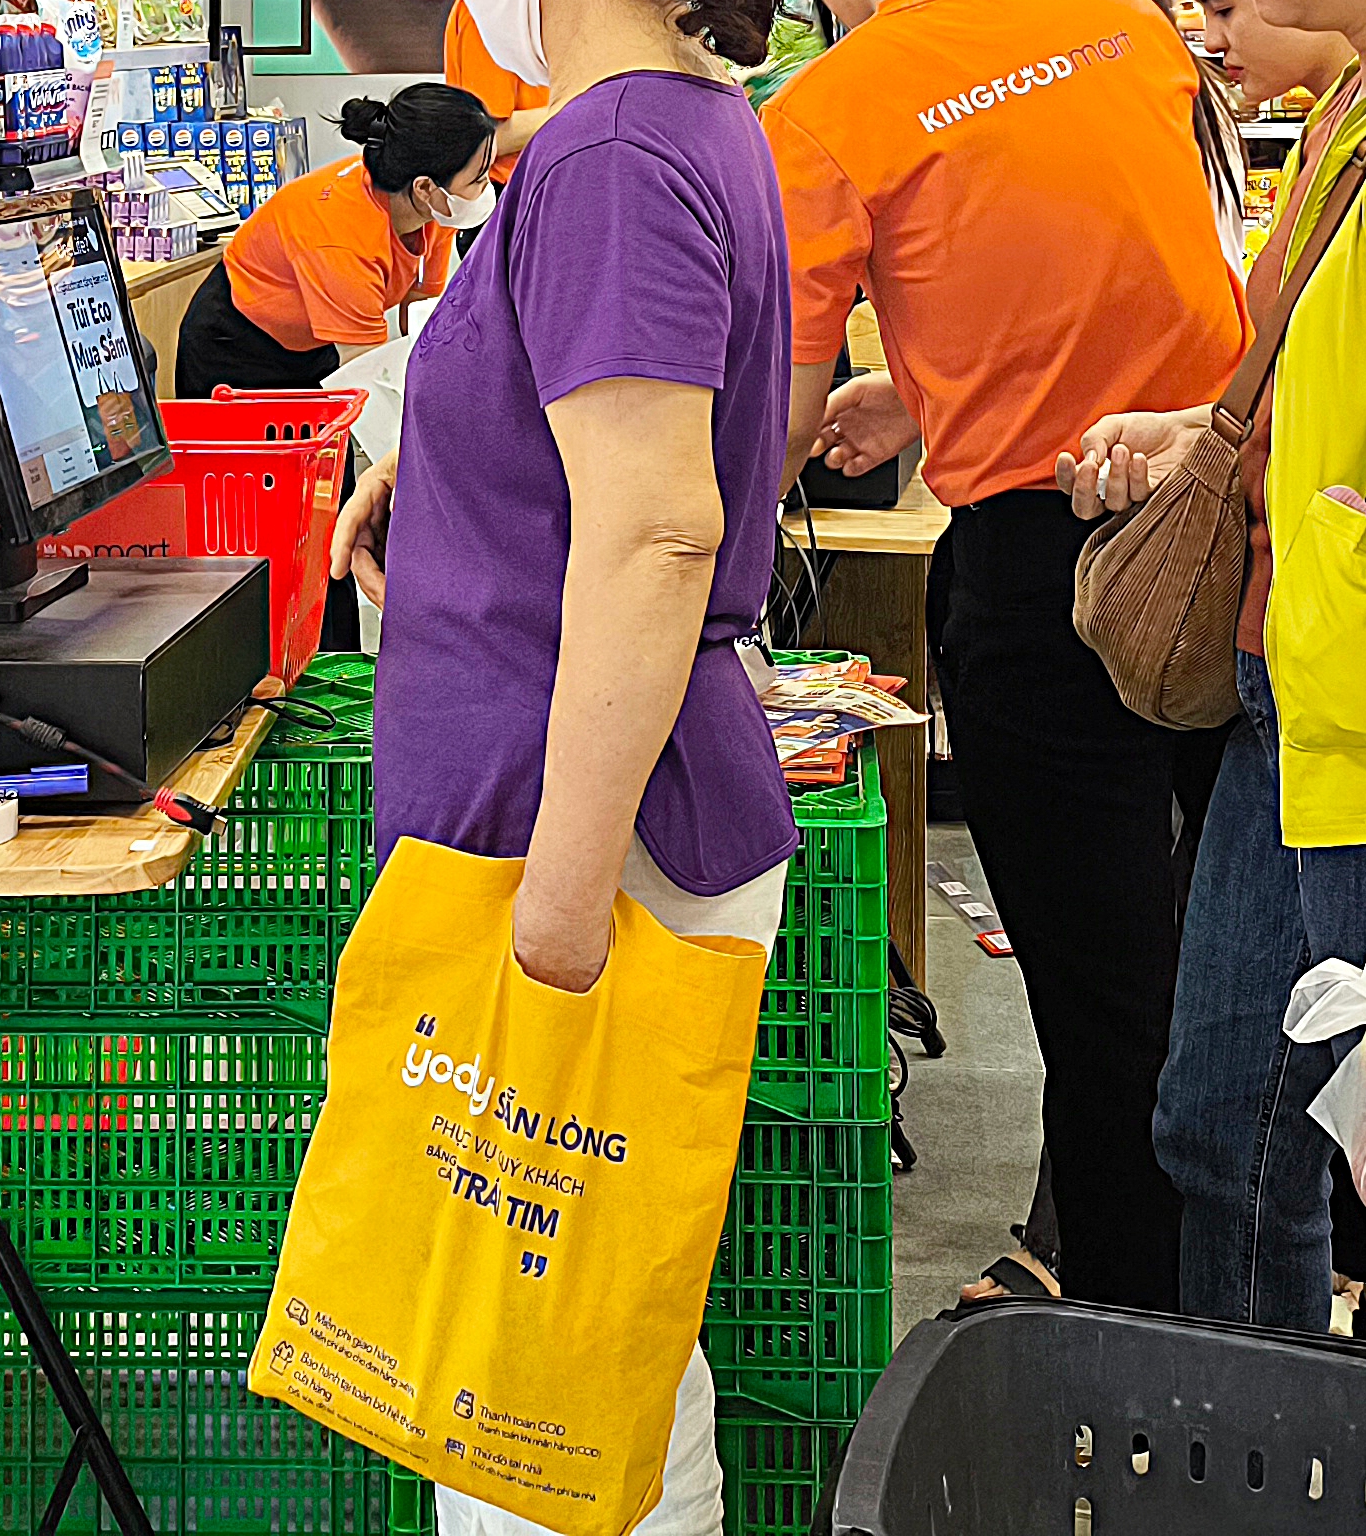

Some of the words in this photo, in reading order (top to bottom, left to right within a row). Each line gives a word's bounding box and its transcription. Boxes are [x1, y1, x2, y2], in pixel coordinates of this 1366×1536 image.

[66, 298, 90, 331] Túi
[87, 297, 112, 325] Eco
[72, 340, 102, 373] Mua
[99, 327, 129, 363] Sắm
[401, 1042, 495, 1116] yody
[544, 1114, 628, 1163] LÒNG
[426, 1144, 457, 1166] BẰNG
[431, 1115, 473, 1149] PHỤC
[475, 1134, 497, 1162] VỤ
[523, 1163, 585, 1198] KHÁCH
[438, 1164, 452, 1182] CẢ
[506, 1195, 560, 1238] TIM
[480, 1405, 511, 1424] Thanh
[538, 1421, 566, 1436] COD
